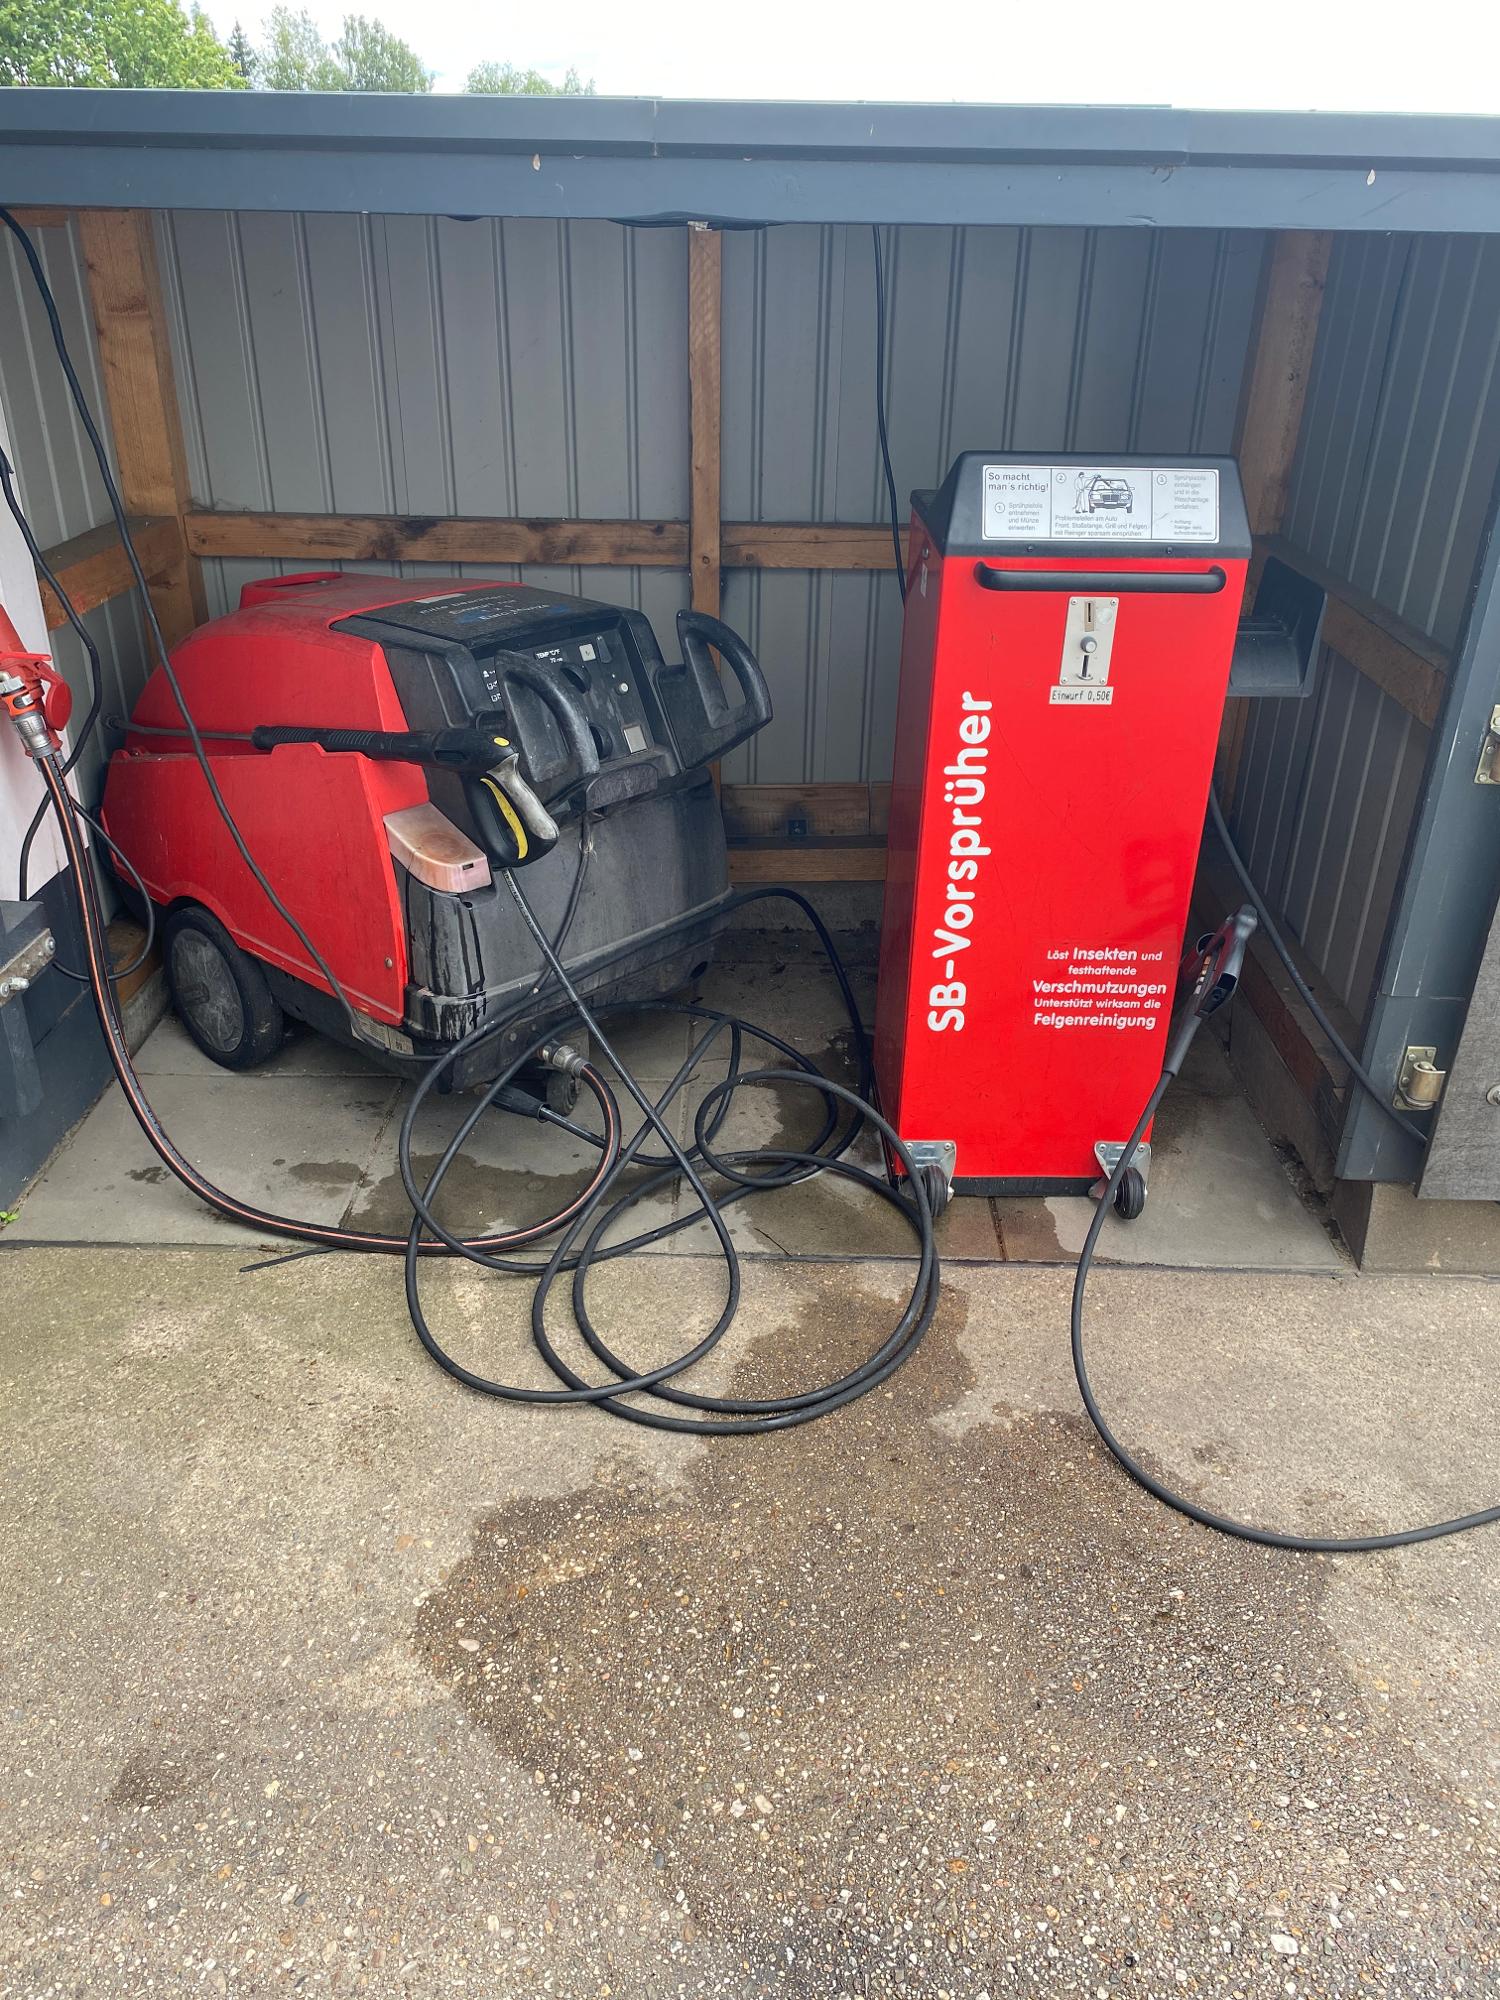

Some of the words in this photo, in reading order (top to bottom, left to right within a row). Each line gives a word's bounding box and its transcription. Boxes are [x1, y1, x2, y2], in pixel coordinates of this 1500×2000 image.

[988, 472, 1000, 481] So
[1002, 472, 1030, 481] macht
[1017, 483, 1049, 493] richtig!
[1052, 690, 1084, 701] Einwurf
[1087, 690, 1111, 702] 0,50€
[927, 691, 993, 1032] SB-Vorsprüher
[1047, 950, 1070, 960] Löst
[1073, 947, 1138, 961] Insekten
[1141, 951, 1163, 961] und
[1068, 965, 1137, 976] festhaftende
[1032, 980, 1167, 997] Verschmutzungen
[1034, 998, 1094, 1009] Unterstützt
[1095, 998, 1141, 1009] wirksam
[1143, 998, 1162, 1009] die
[1033, 1012, 1157, 1031] Felgenreinigung
